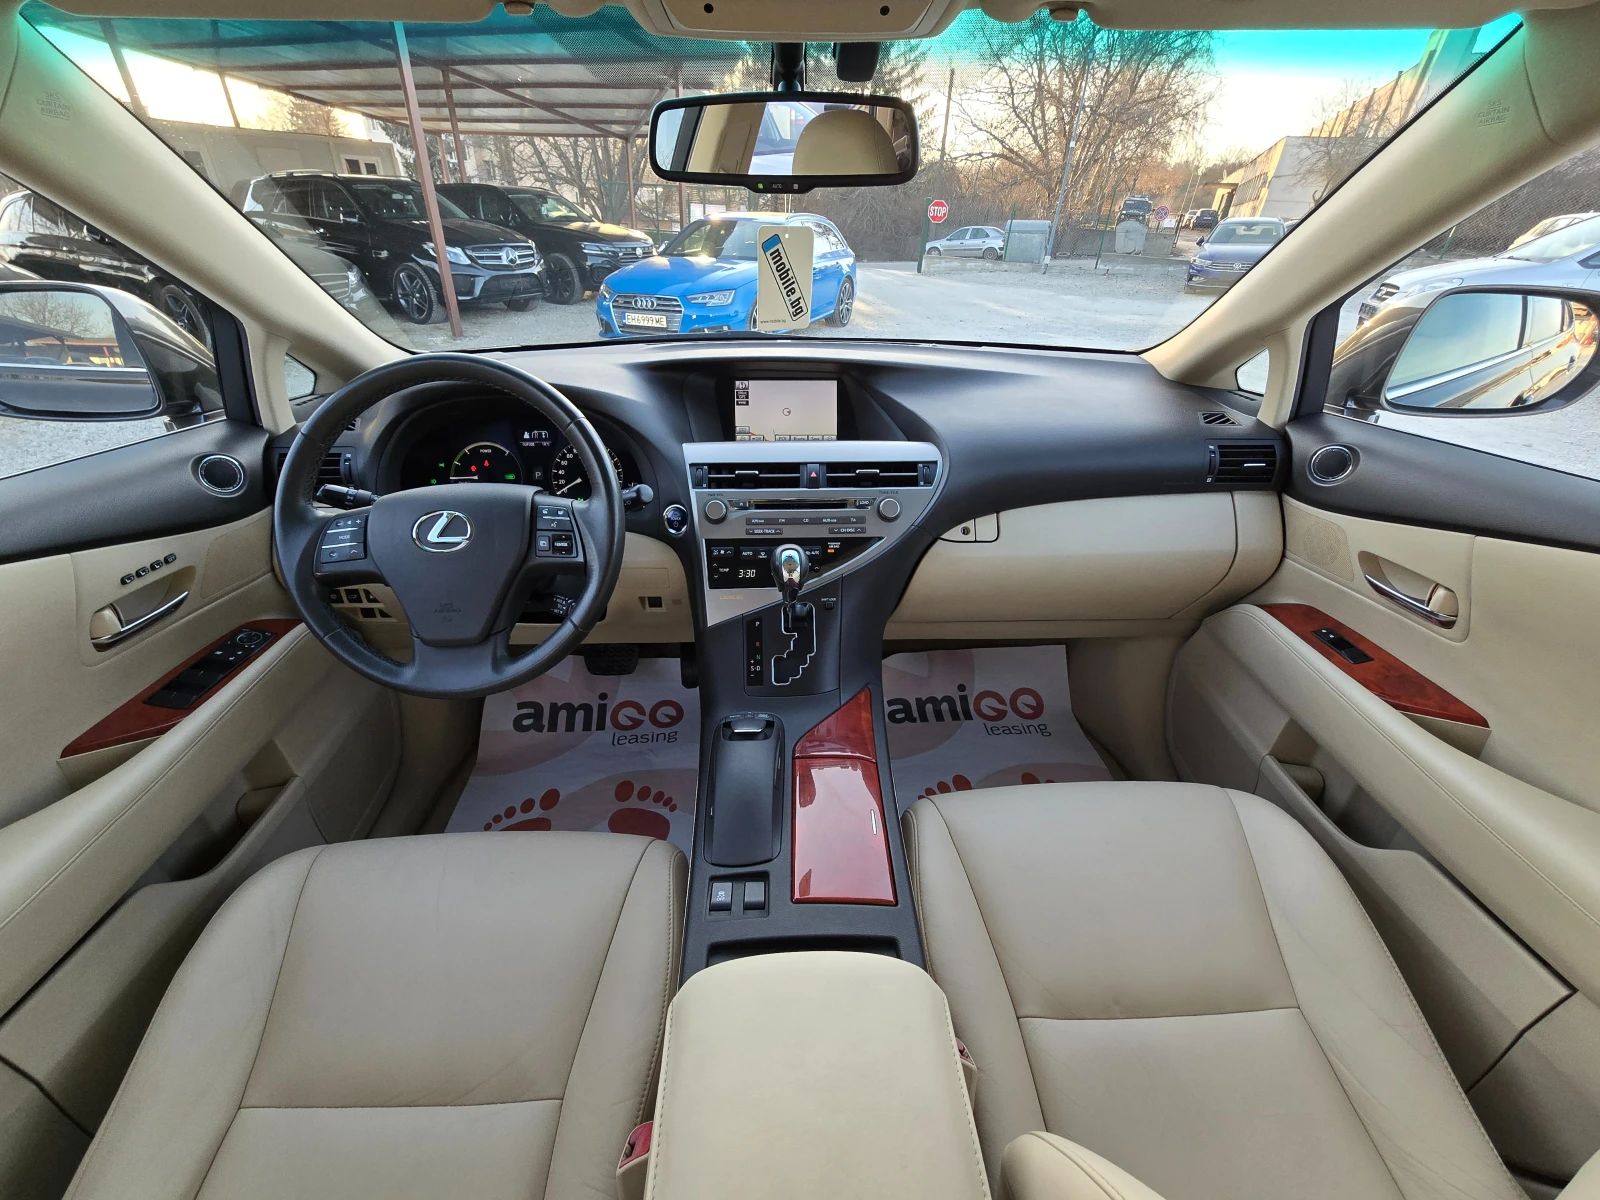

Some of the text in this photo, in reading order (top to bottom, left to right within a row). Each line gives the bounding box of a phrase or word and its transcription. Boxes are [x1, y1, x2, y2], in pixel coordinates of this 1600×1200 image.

[44, 91, 60, 100] SRS
[37, 99, 71, 112] CURTAIN
[1487, 100, 1502, 108] SRS
[40, 106, 71, 119] AIRBAG
[1477, 106, 1510, 119] CURTAIN
[1478, 114, 1507, 125] AIRBAG
[930, 206, 947, 217] STOP
[769, 248, 804, 317] mobile.bg
[535, 471, 542, 479] P
[738, 569, 756, 578] 3:30
[983, 721, 1052, 737] leasing
[611, 730, 679, 747] leasing
